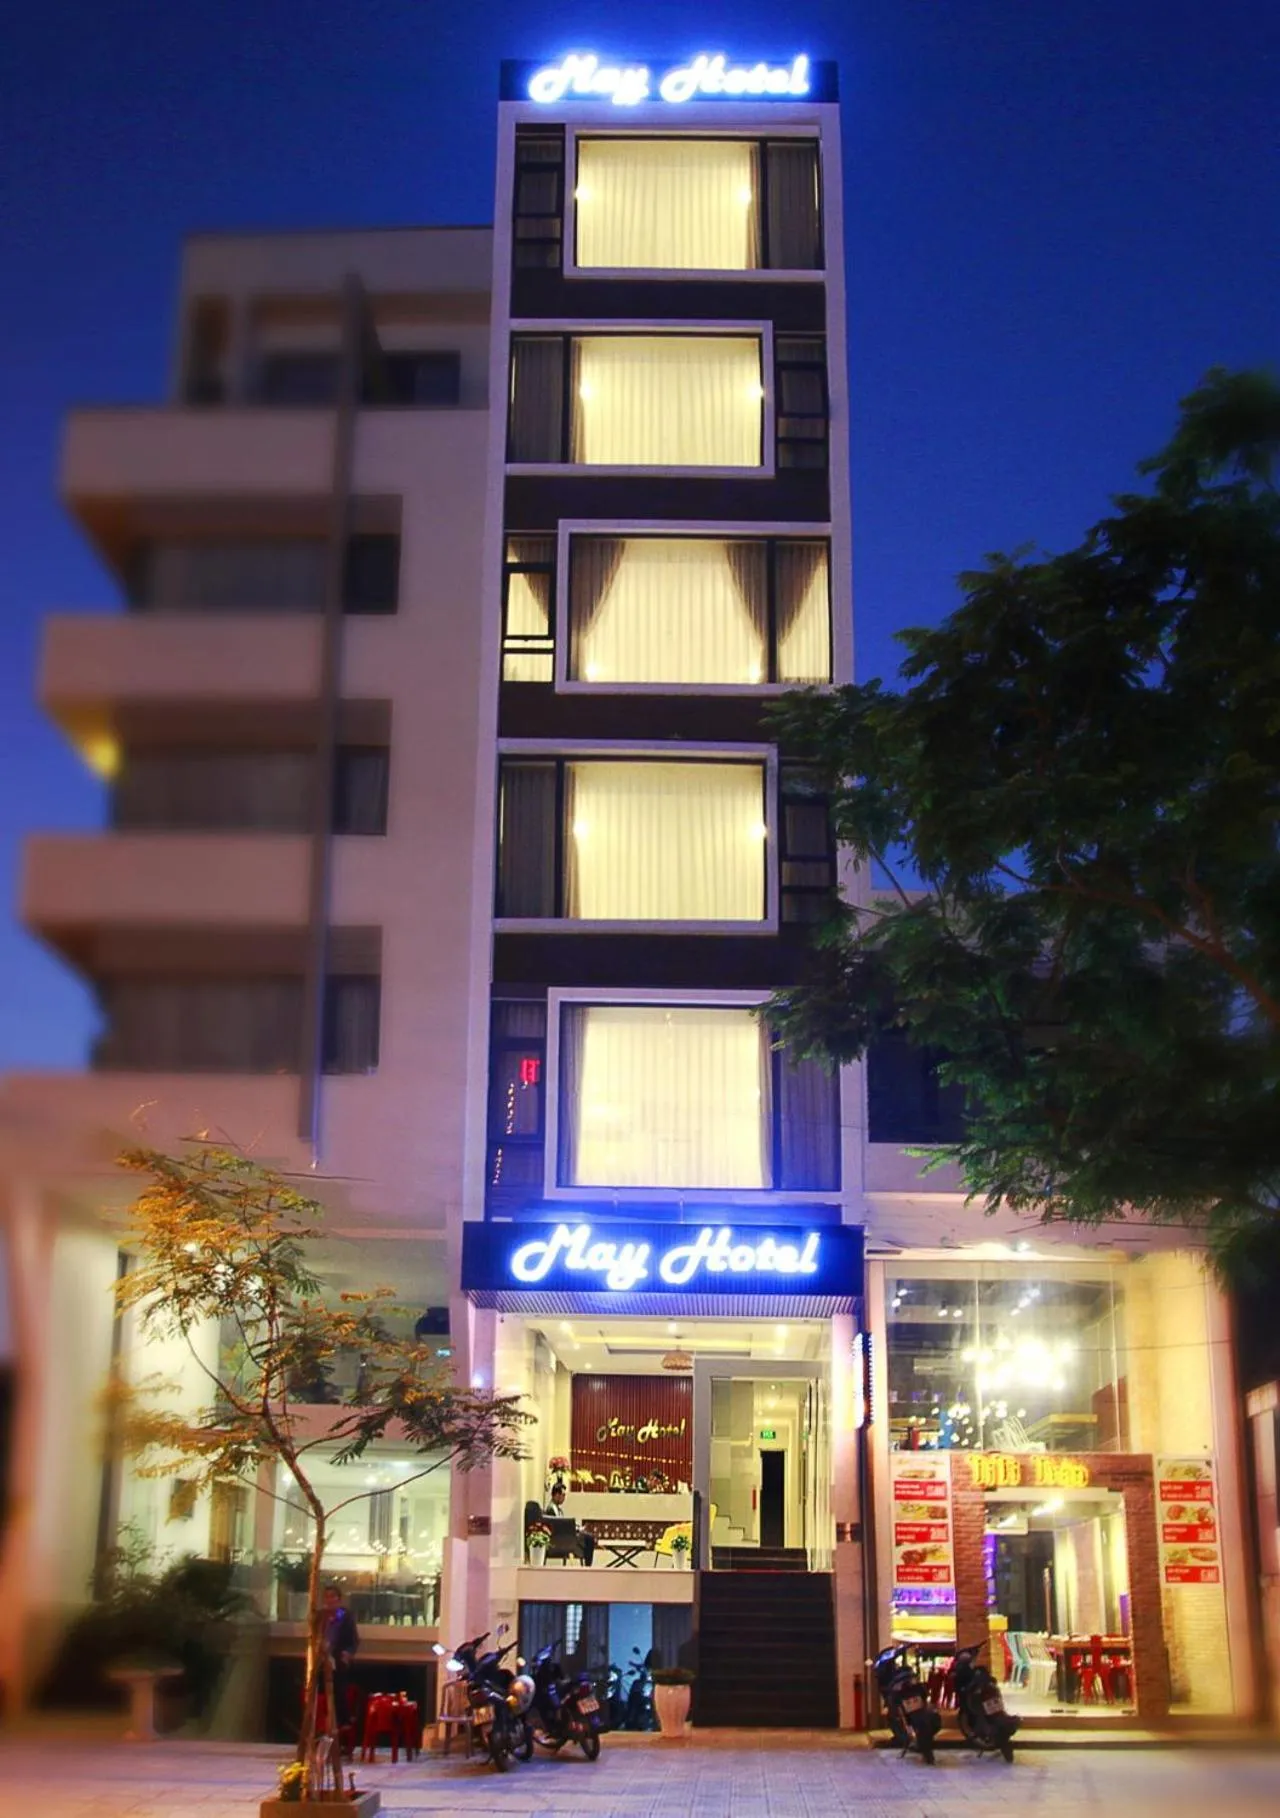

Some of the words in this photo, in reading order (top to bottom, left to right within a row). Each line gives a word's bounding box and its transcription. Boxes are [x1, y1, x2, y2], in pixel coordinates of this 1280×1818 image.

[527, 54, 649, 104] May
[659, 53, 810, 103] Hotel
[511, 1223, 650, 1290] May
[659, 1225, 821, 1285] Hotel
[637, 1417, 686, 1443] Hotel
